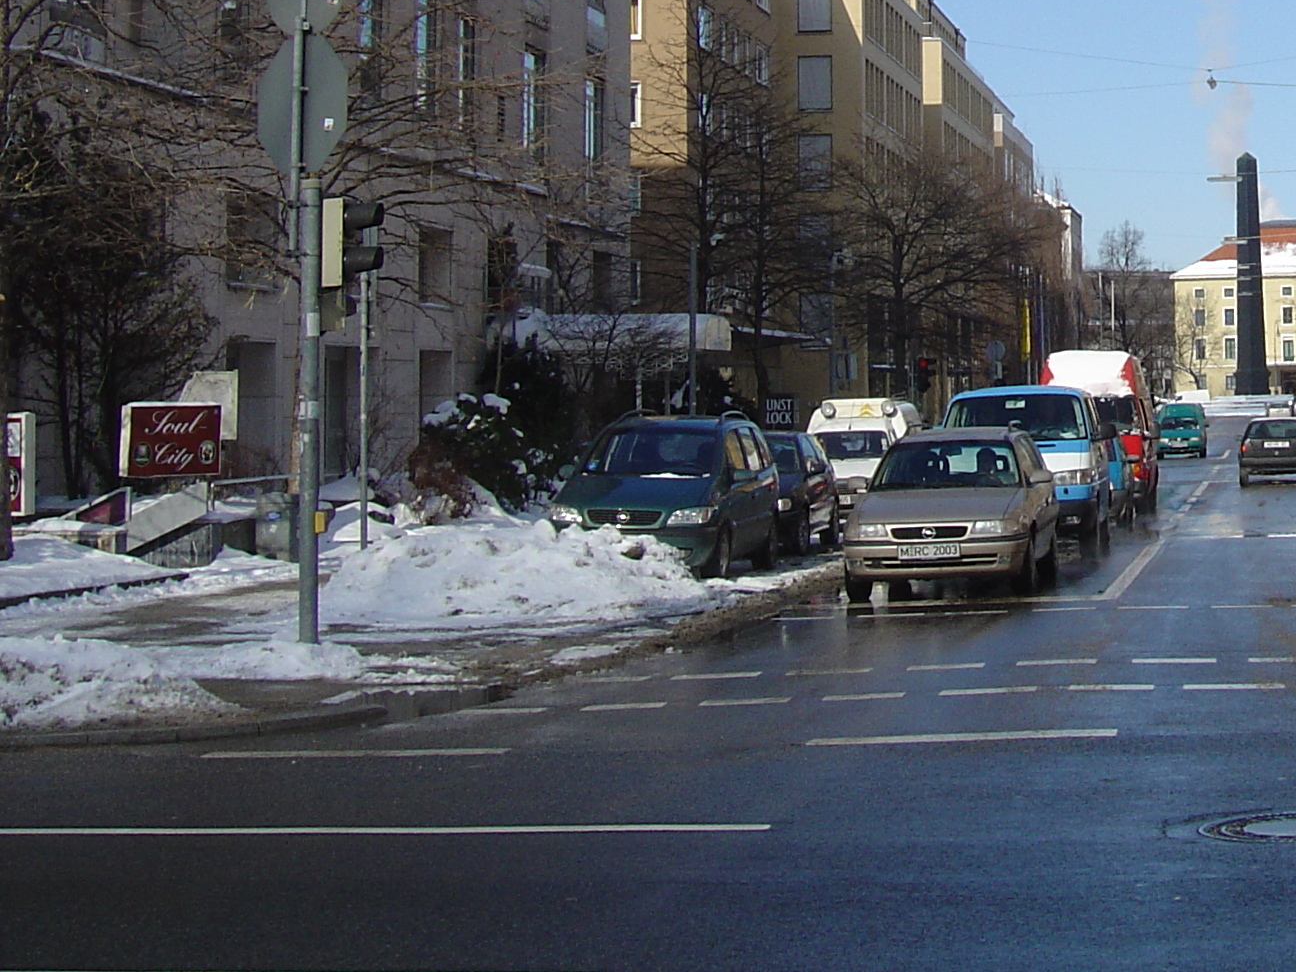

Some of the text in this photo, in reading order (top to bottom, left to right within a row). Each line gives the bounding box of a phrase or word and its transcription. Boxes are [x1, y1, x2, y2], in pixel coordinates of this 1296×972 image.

[766, 411, 792, 424] LOCK
[154, 442, 194, 471] City
[933, 545, 958, 557] 2003
